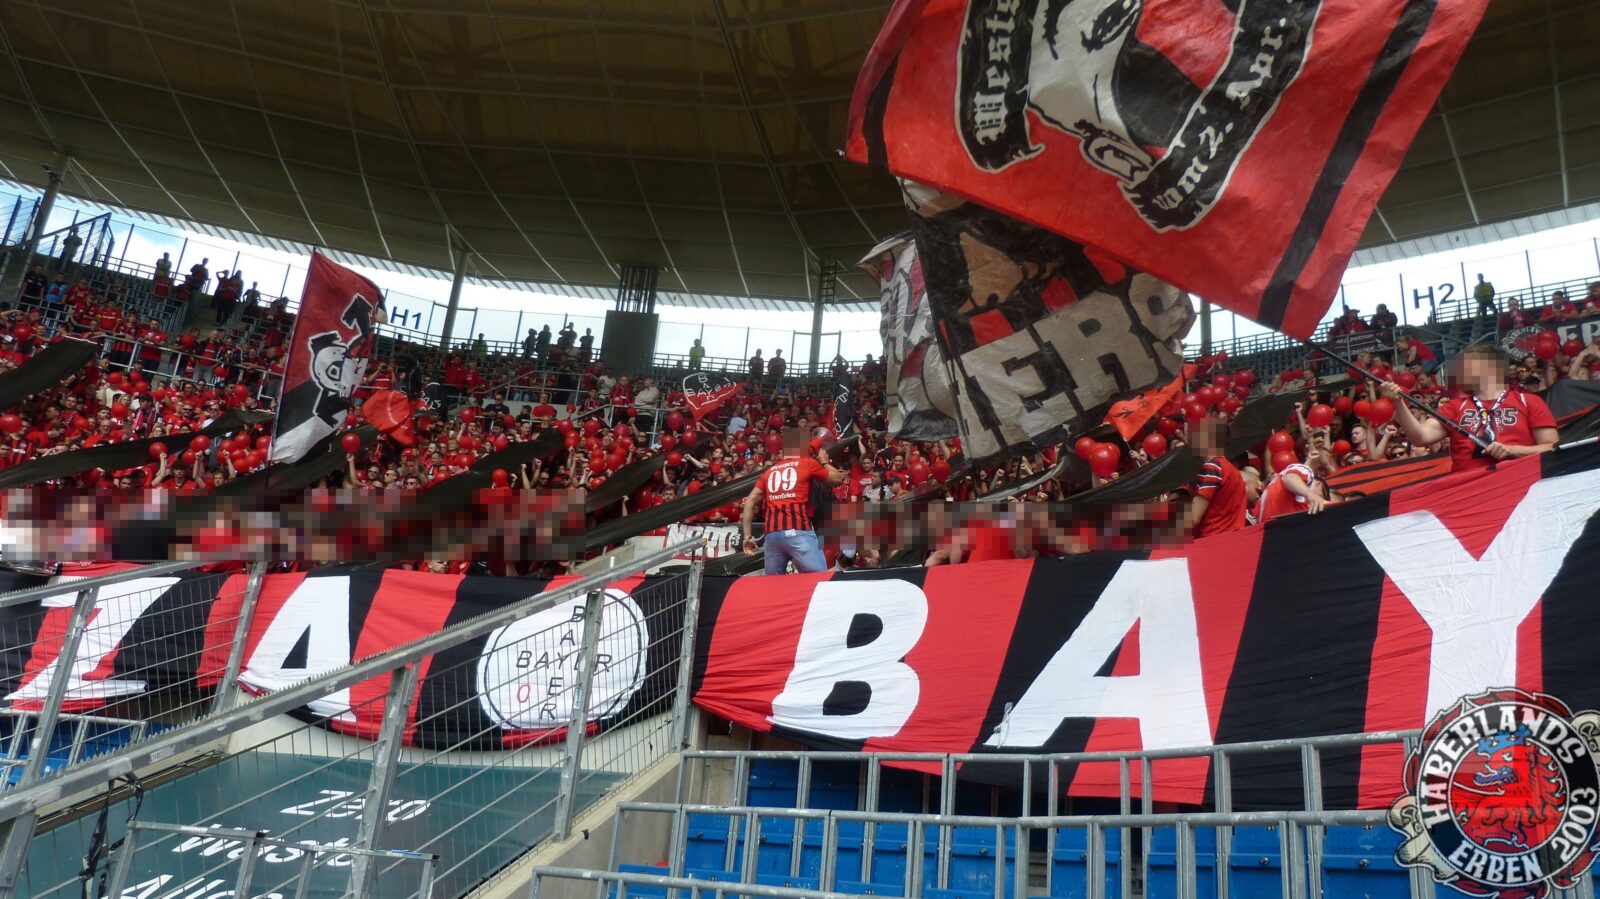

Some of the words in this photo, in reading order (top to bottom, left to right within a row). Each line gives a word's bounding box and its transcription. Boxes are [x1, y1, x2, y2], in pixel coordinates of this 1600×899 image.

[1412, 283, 1455, 309] H2
[390, 306, 422, 330] H1
[767, 467, 798, 493] 09
[766, 472, 1600, 752] BAY
[515, 650, 613, 673] BAYR
[280, 789, 431, 822] Zeo
